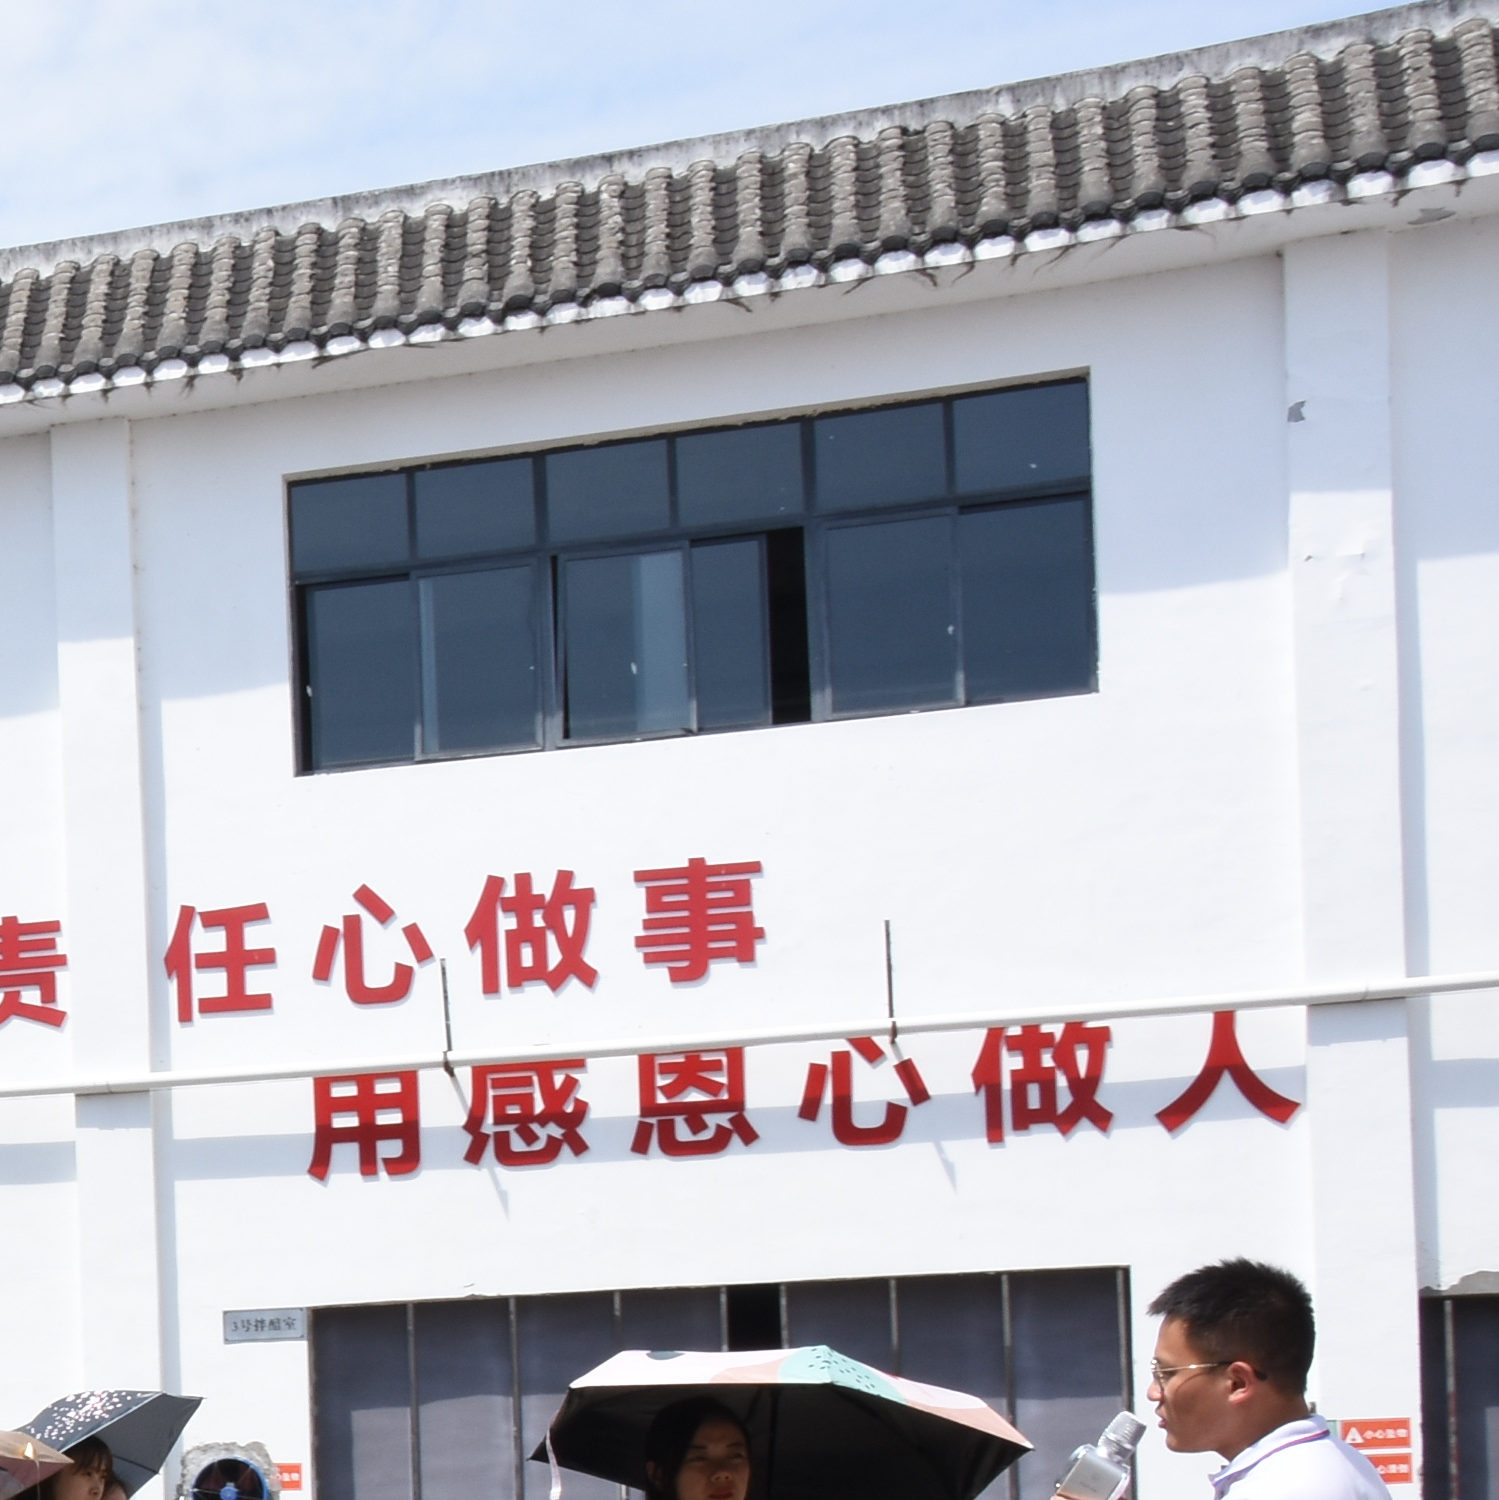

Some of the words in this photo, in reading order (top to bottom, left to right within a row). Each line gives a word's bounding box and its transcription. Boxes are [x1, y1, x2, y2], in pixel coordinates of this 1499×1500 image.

[307, 1009, 1302, 1182] 用感恩心做人
